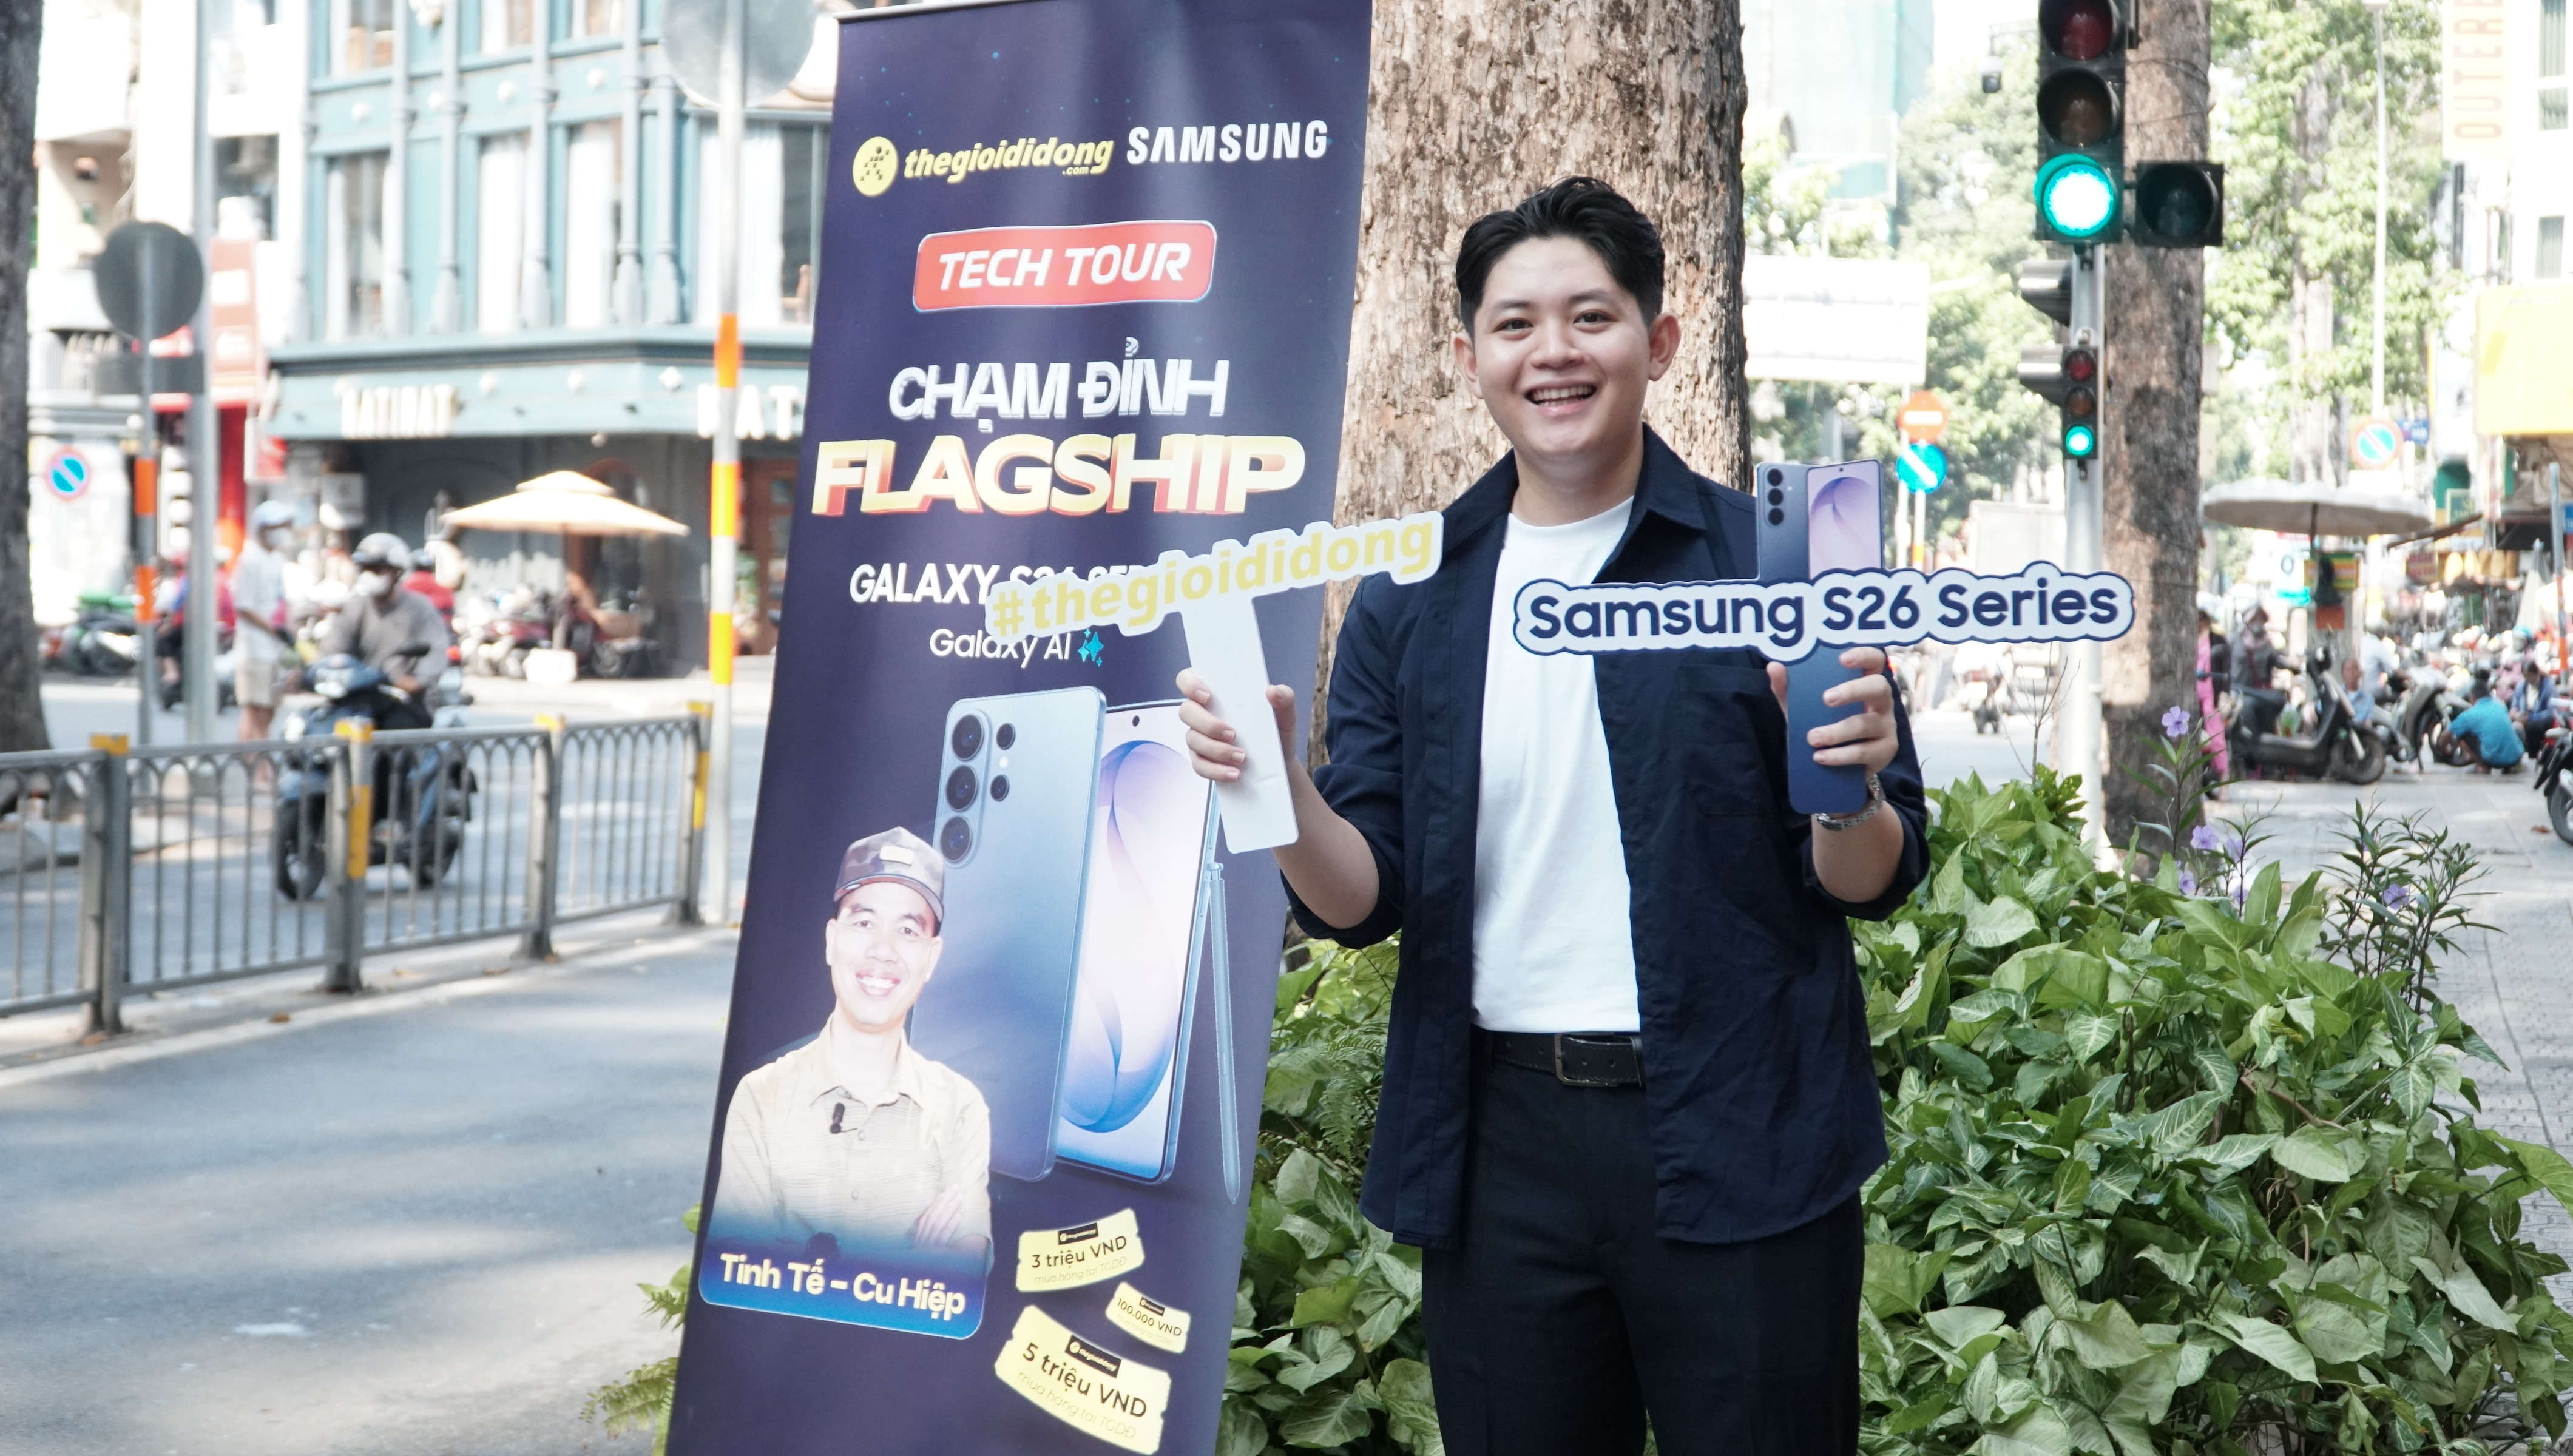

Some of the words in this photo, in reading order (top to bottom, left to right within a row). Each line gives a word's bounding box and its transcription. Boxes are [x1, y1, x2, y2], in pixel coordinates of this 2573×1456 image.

[904, 137, 1114, 183] thegioididong
[1126, 120, 1328, 164] SAMSUNG
[939, 248, 1054, 291] TECH
[1064, 242, 1191, 286] TOUR
[888, 362, 1070, 433] CHẠM
[1077, 336, 1230, 417] ĐỈNH
[811, 433, 1307, 516] FLAGSHIP
[850, 562, 1000, 604] GALAXY
[992, 520, 1434, 636] #thegioididong
[1529, 595, 1805, 648] Samsung
[1822, 584, 1921, 631] S26
[1937, 576, 2119, 628] Series
[929, 628, 1036, 668] Galaxy
[1043, 633, 1072, 660] AI
[1031, 1254, 1041, 1268] 3
[1046, 1250, 1085, 1269] triệu
[1090, 1235, 1128, 1258] VND
[720, 1253, 781, 1289] Tinh
[788, 1258, 826, 1295] Tế
[853, 1272, 894, 1305] Cu
[897, 1277, 966, 1321] Hiệp
[1117, 1298, 1154, 1326] 100.000
[1158, 1321, 1182, 1336] VND
[1023, 1341, 1039, 1362] 5
[1041, 1354, 1091, 1397] triệu
[1100, 1383, 1147, 1418] VND
